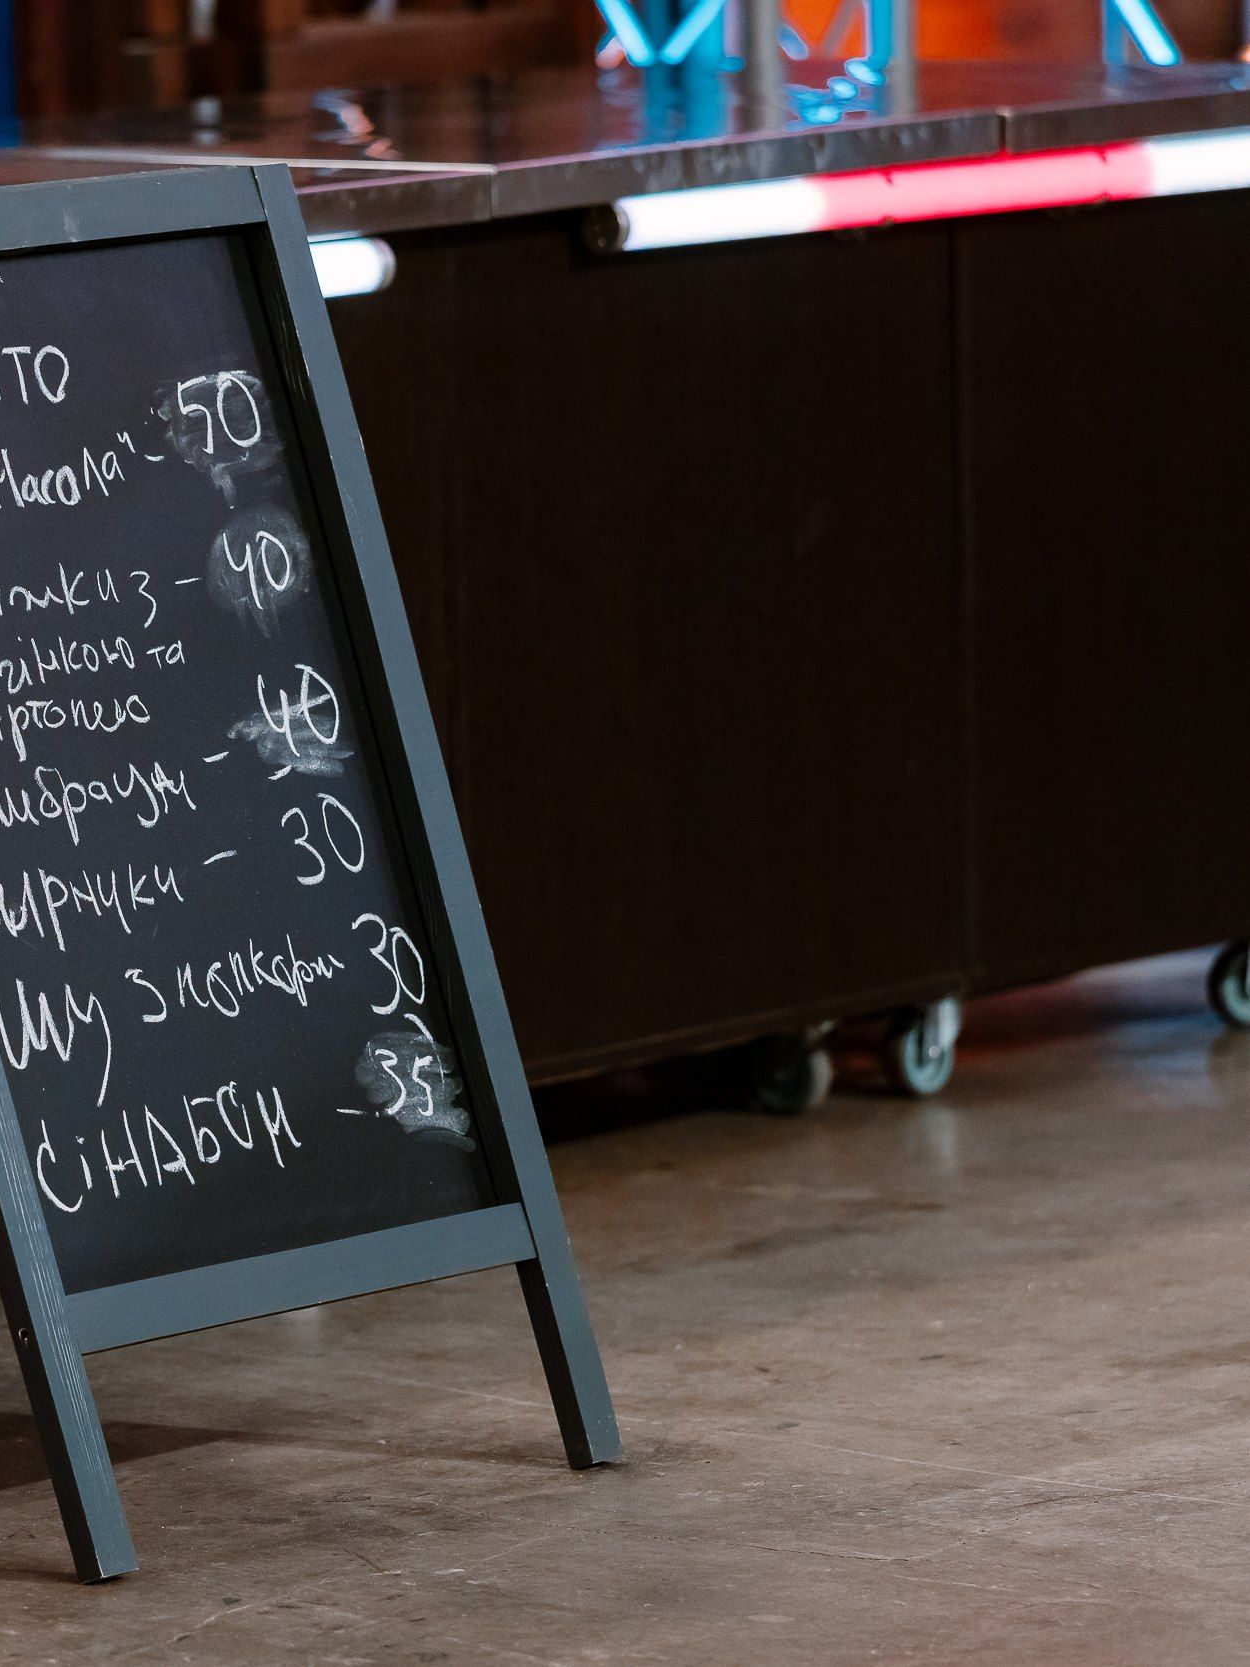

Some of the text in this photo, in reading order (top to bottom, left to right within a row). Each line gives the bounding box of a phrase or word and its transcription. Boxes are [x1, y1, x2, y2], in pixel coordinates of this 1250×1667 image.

[177, 371, 261, 454] 50
[223, 530, 291, 609] 40
[146, 640, 186, 669] та
[281, 792, 365, 886] 30
[351, 912, 425, 1015] 30
[375, 1048, 435, 1117] 35
